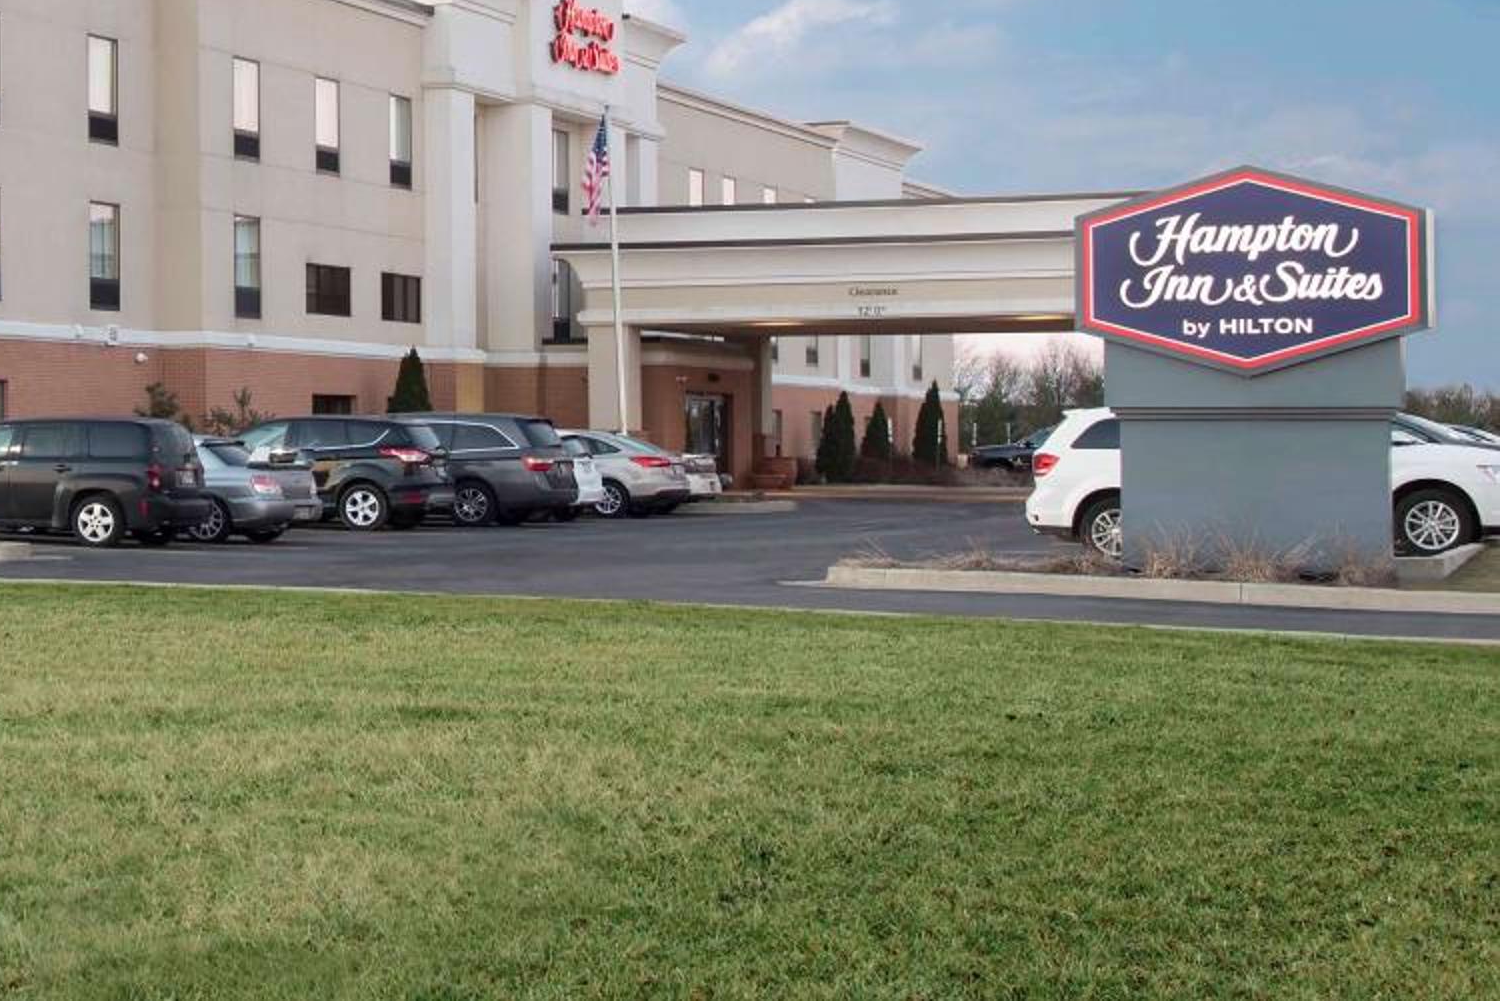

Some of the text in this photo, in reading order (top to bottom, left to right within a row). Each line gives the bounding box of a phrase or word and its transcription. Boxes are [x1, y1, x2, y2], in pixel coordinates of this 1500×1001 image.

[1128, 212, 1359, 267] Hampton
[1119, 260, 1383, 309] Inn & Suites
[1182, 317, 1314, 339] by HILTON
